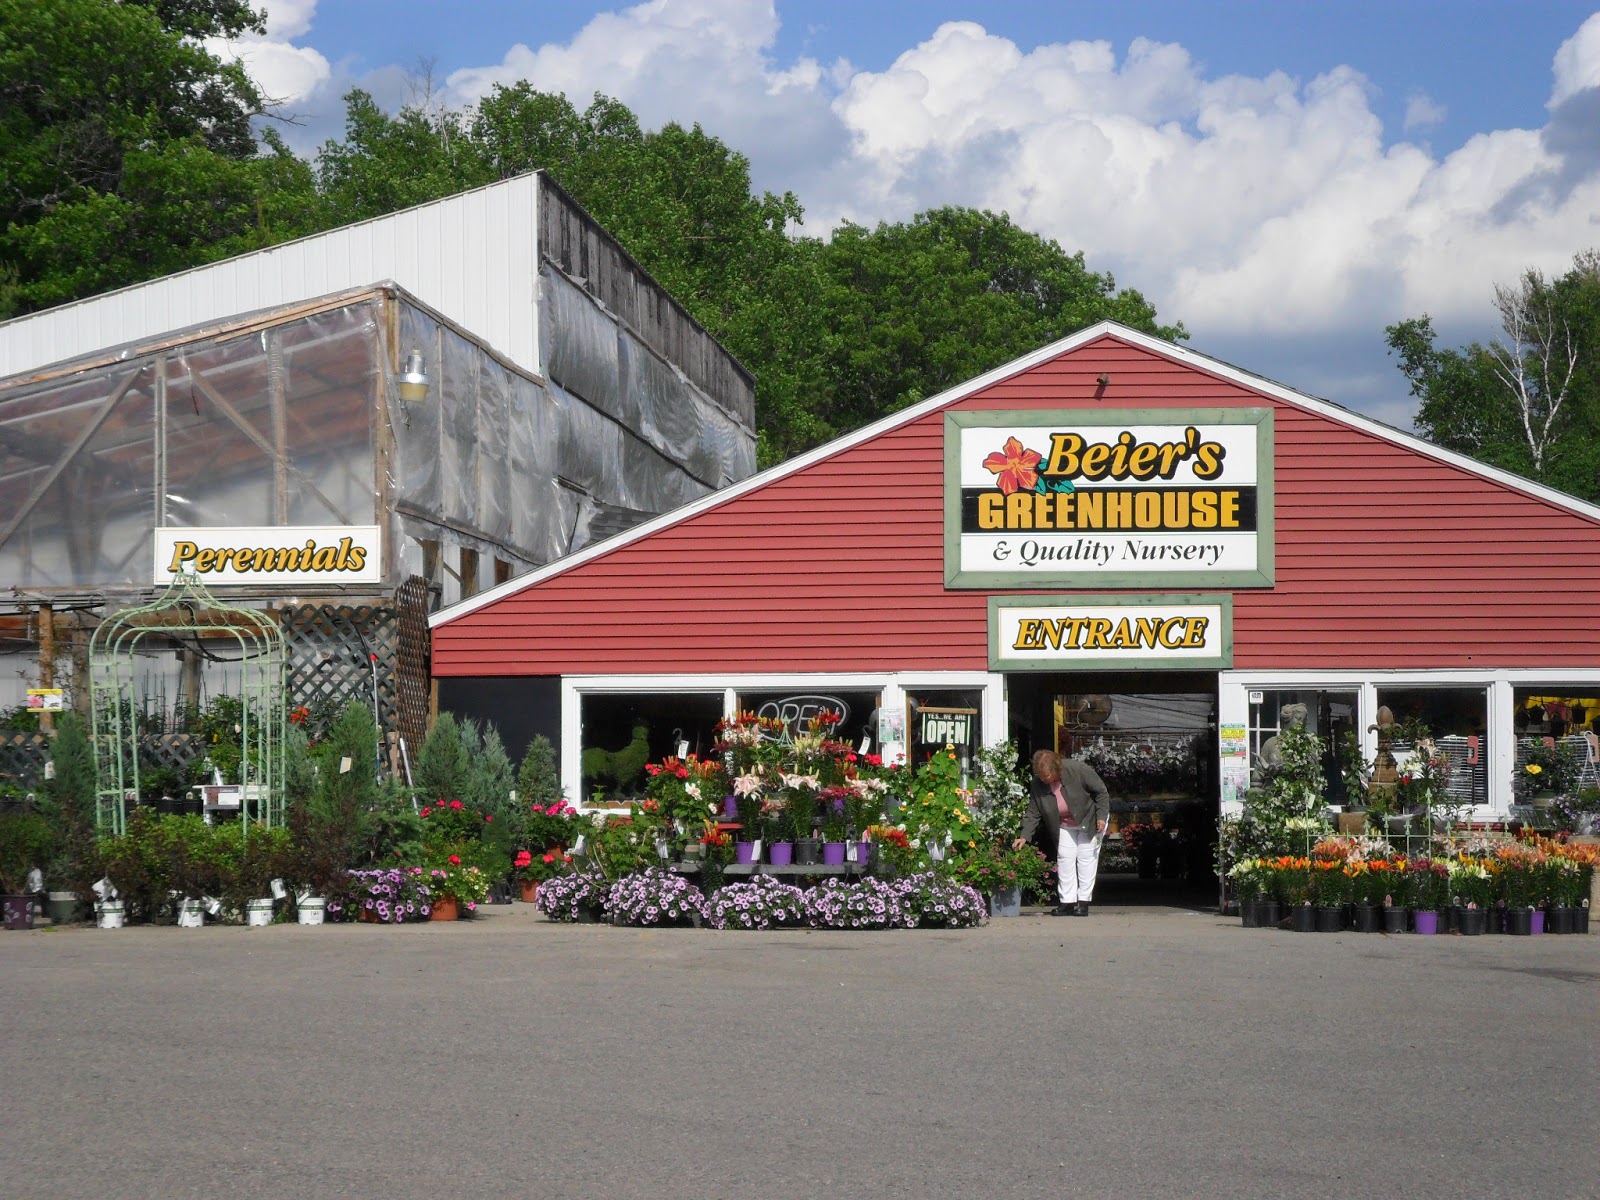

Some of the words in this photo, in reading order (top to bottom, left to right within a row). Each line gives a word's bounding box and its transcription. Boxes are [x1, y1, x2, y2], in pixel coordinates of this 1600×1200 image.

[1043, 426, 1226, 481] Beier's
[978, 491, 1239, 529] GREENHOUSE
[167, 536, 367, 573] Perennials
[992, 540, 1012, 561] &
[1018, 539, 1115, 567] Quality
[1121, 539, 1225, 567] Nursery
[1013, 616, 1210, 650] ENTRANCE
[926, 720, 966, 744] OPEN
